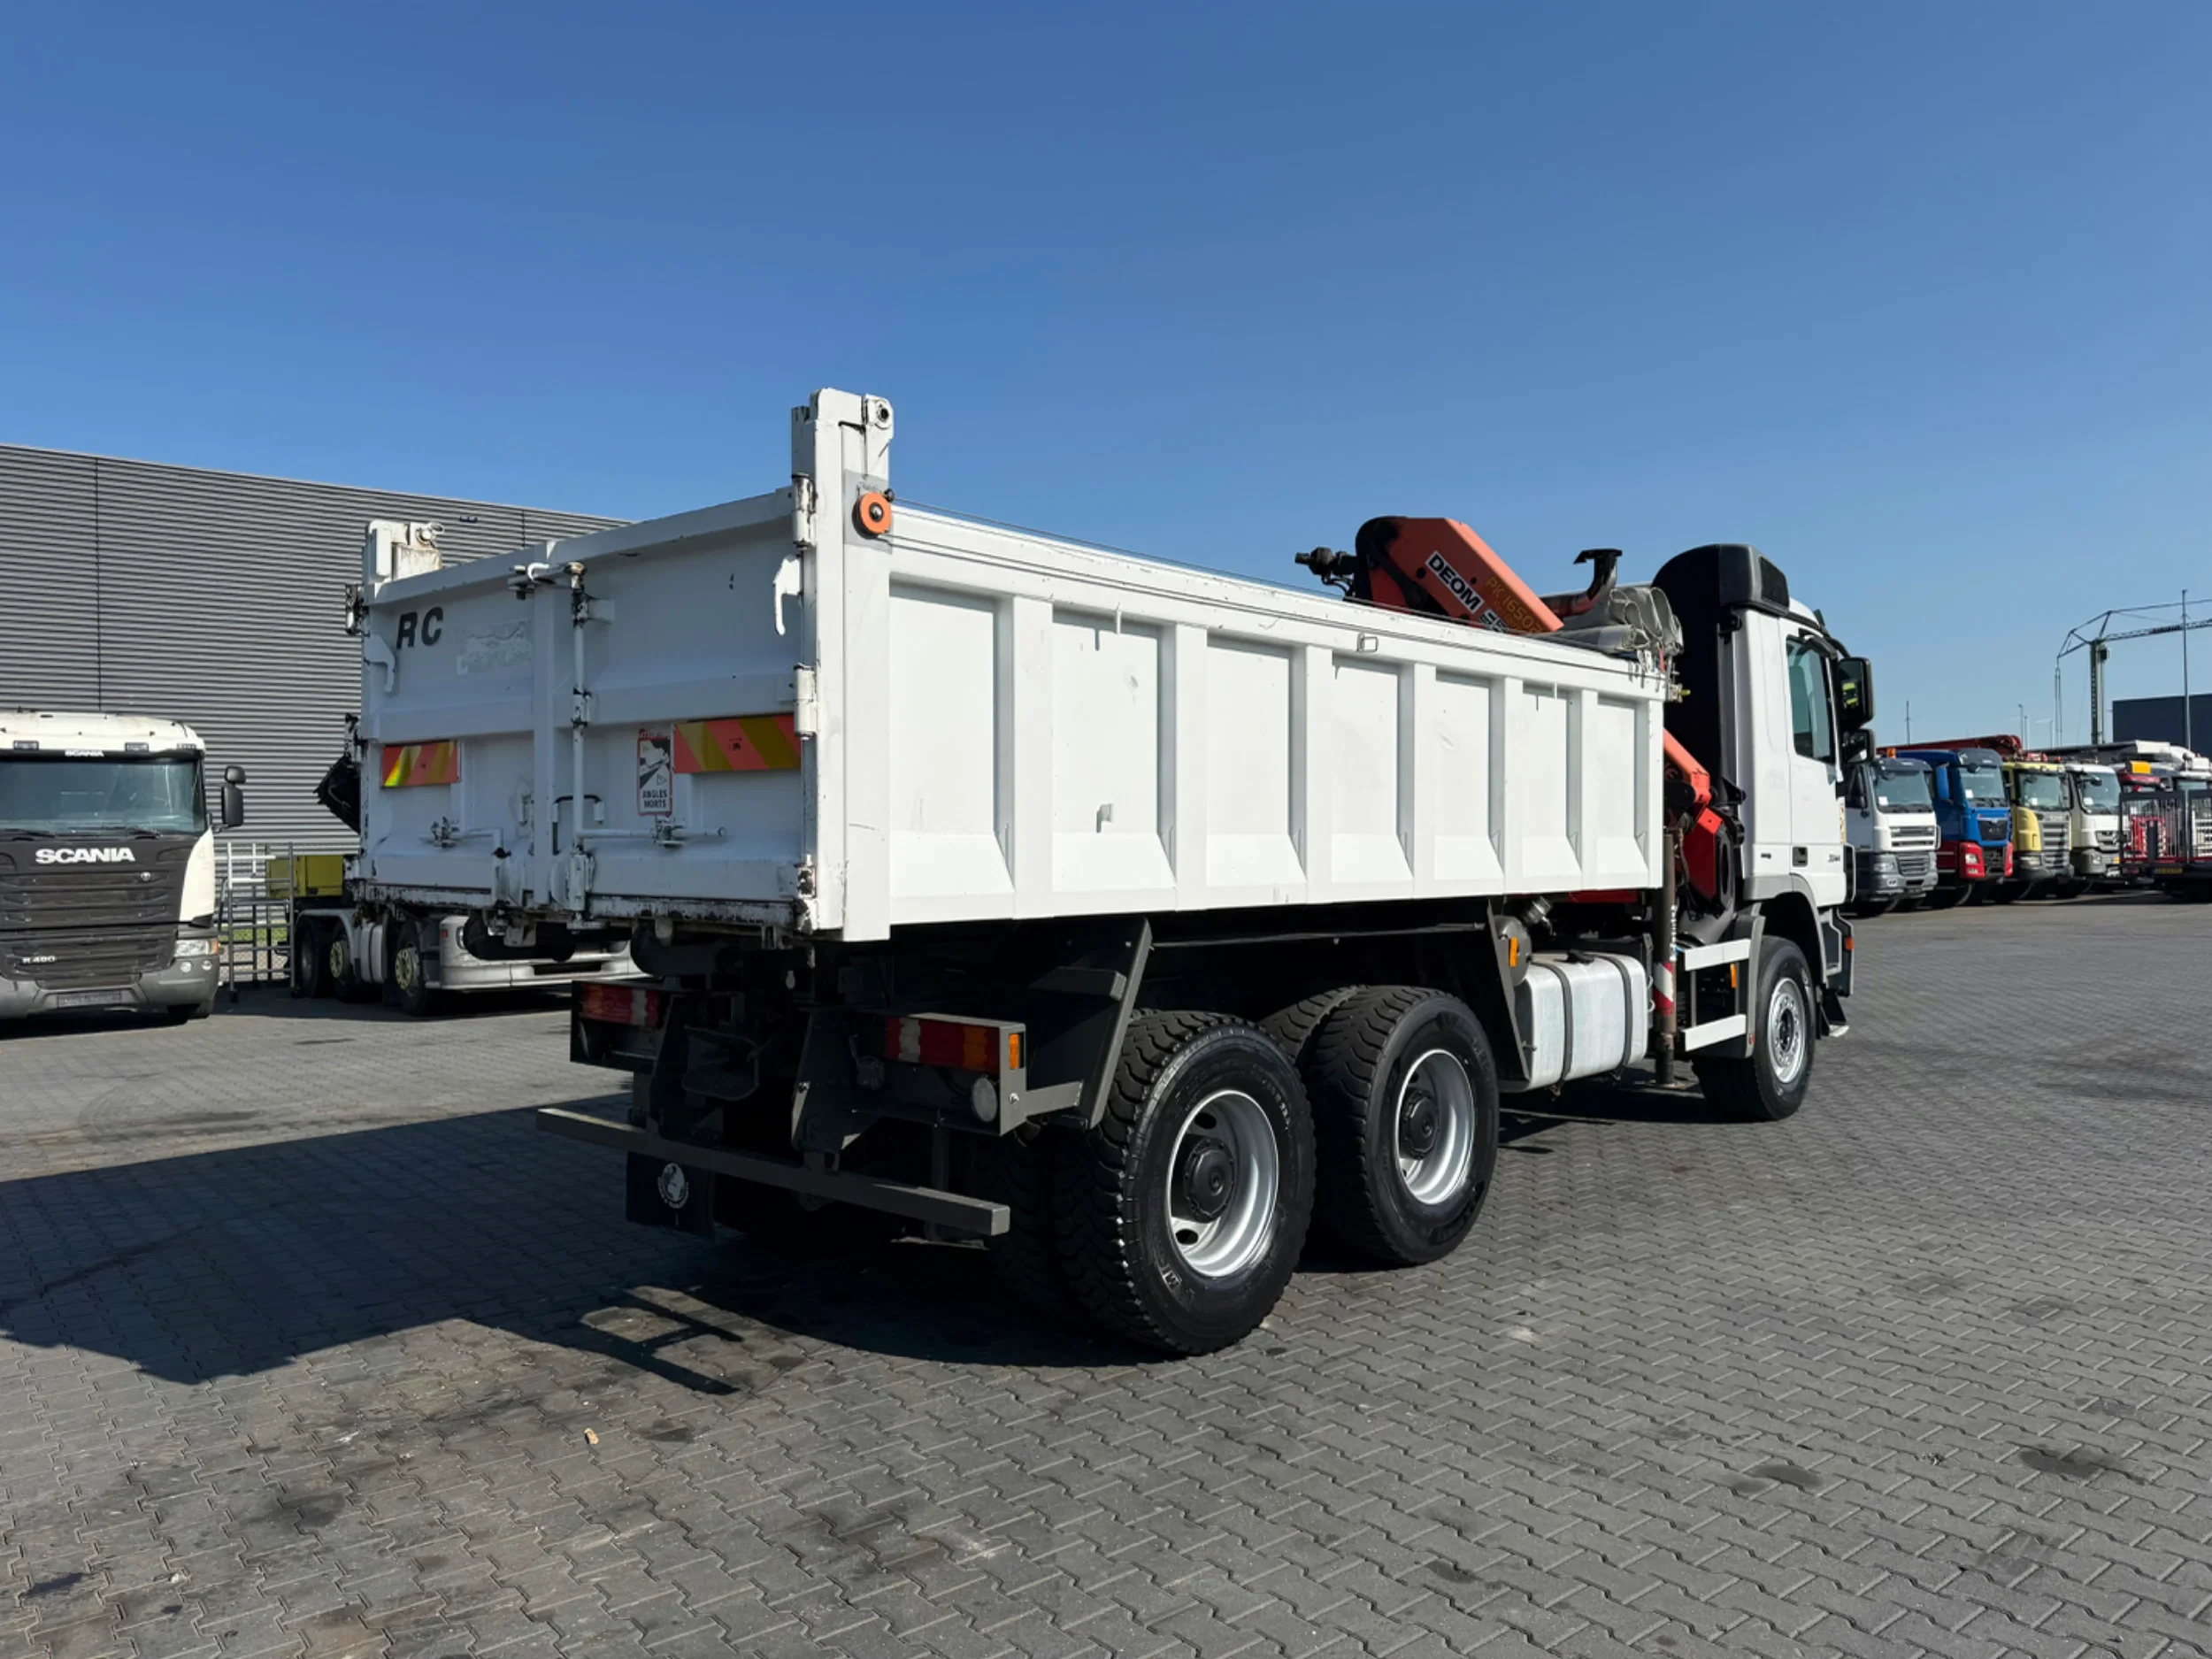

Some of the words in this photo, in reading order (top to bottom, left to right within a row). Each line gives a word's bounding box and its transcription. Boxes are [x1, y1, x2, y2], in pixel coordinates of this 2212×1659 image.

[1428, 553, 1482, 611] DEOM
[1485, 577, 1507, 597] PK
[396, 606, 444, 649] RC
[642, 789, 668, 799] ANGLES
[643, 799, 667, 809] MORTS
[35, 847, 135, 864] SCANIA
